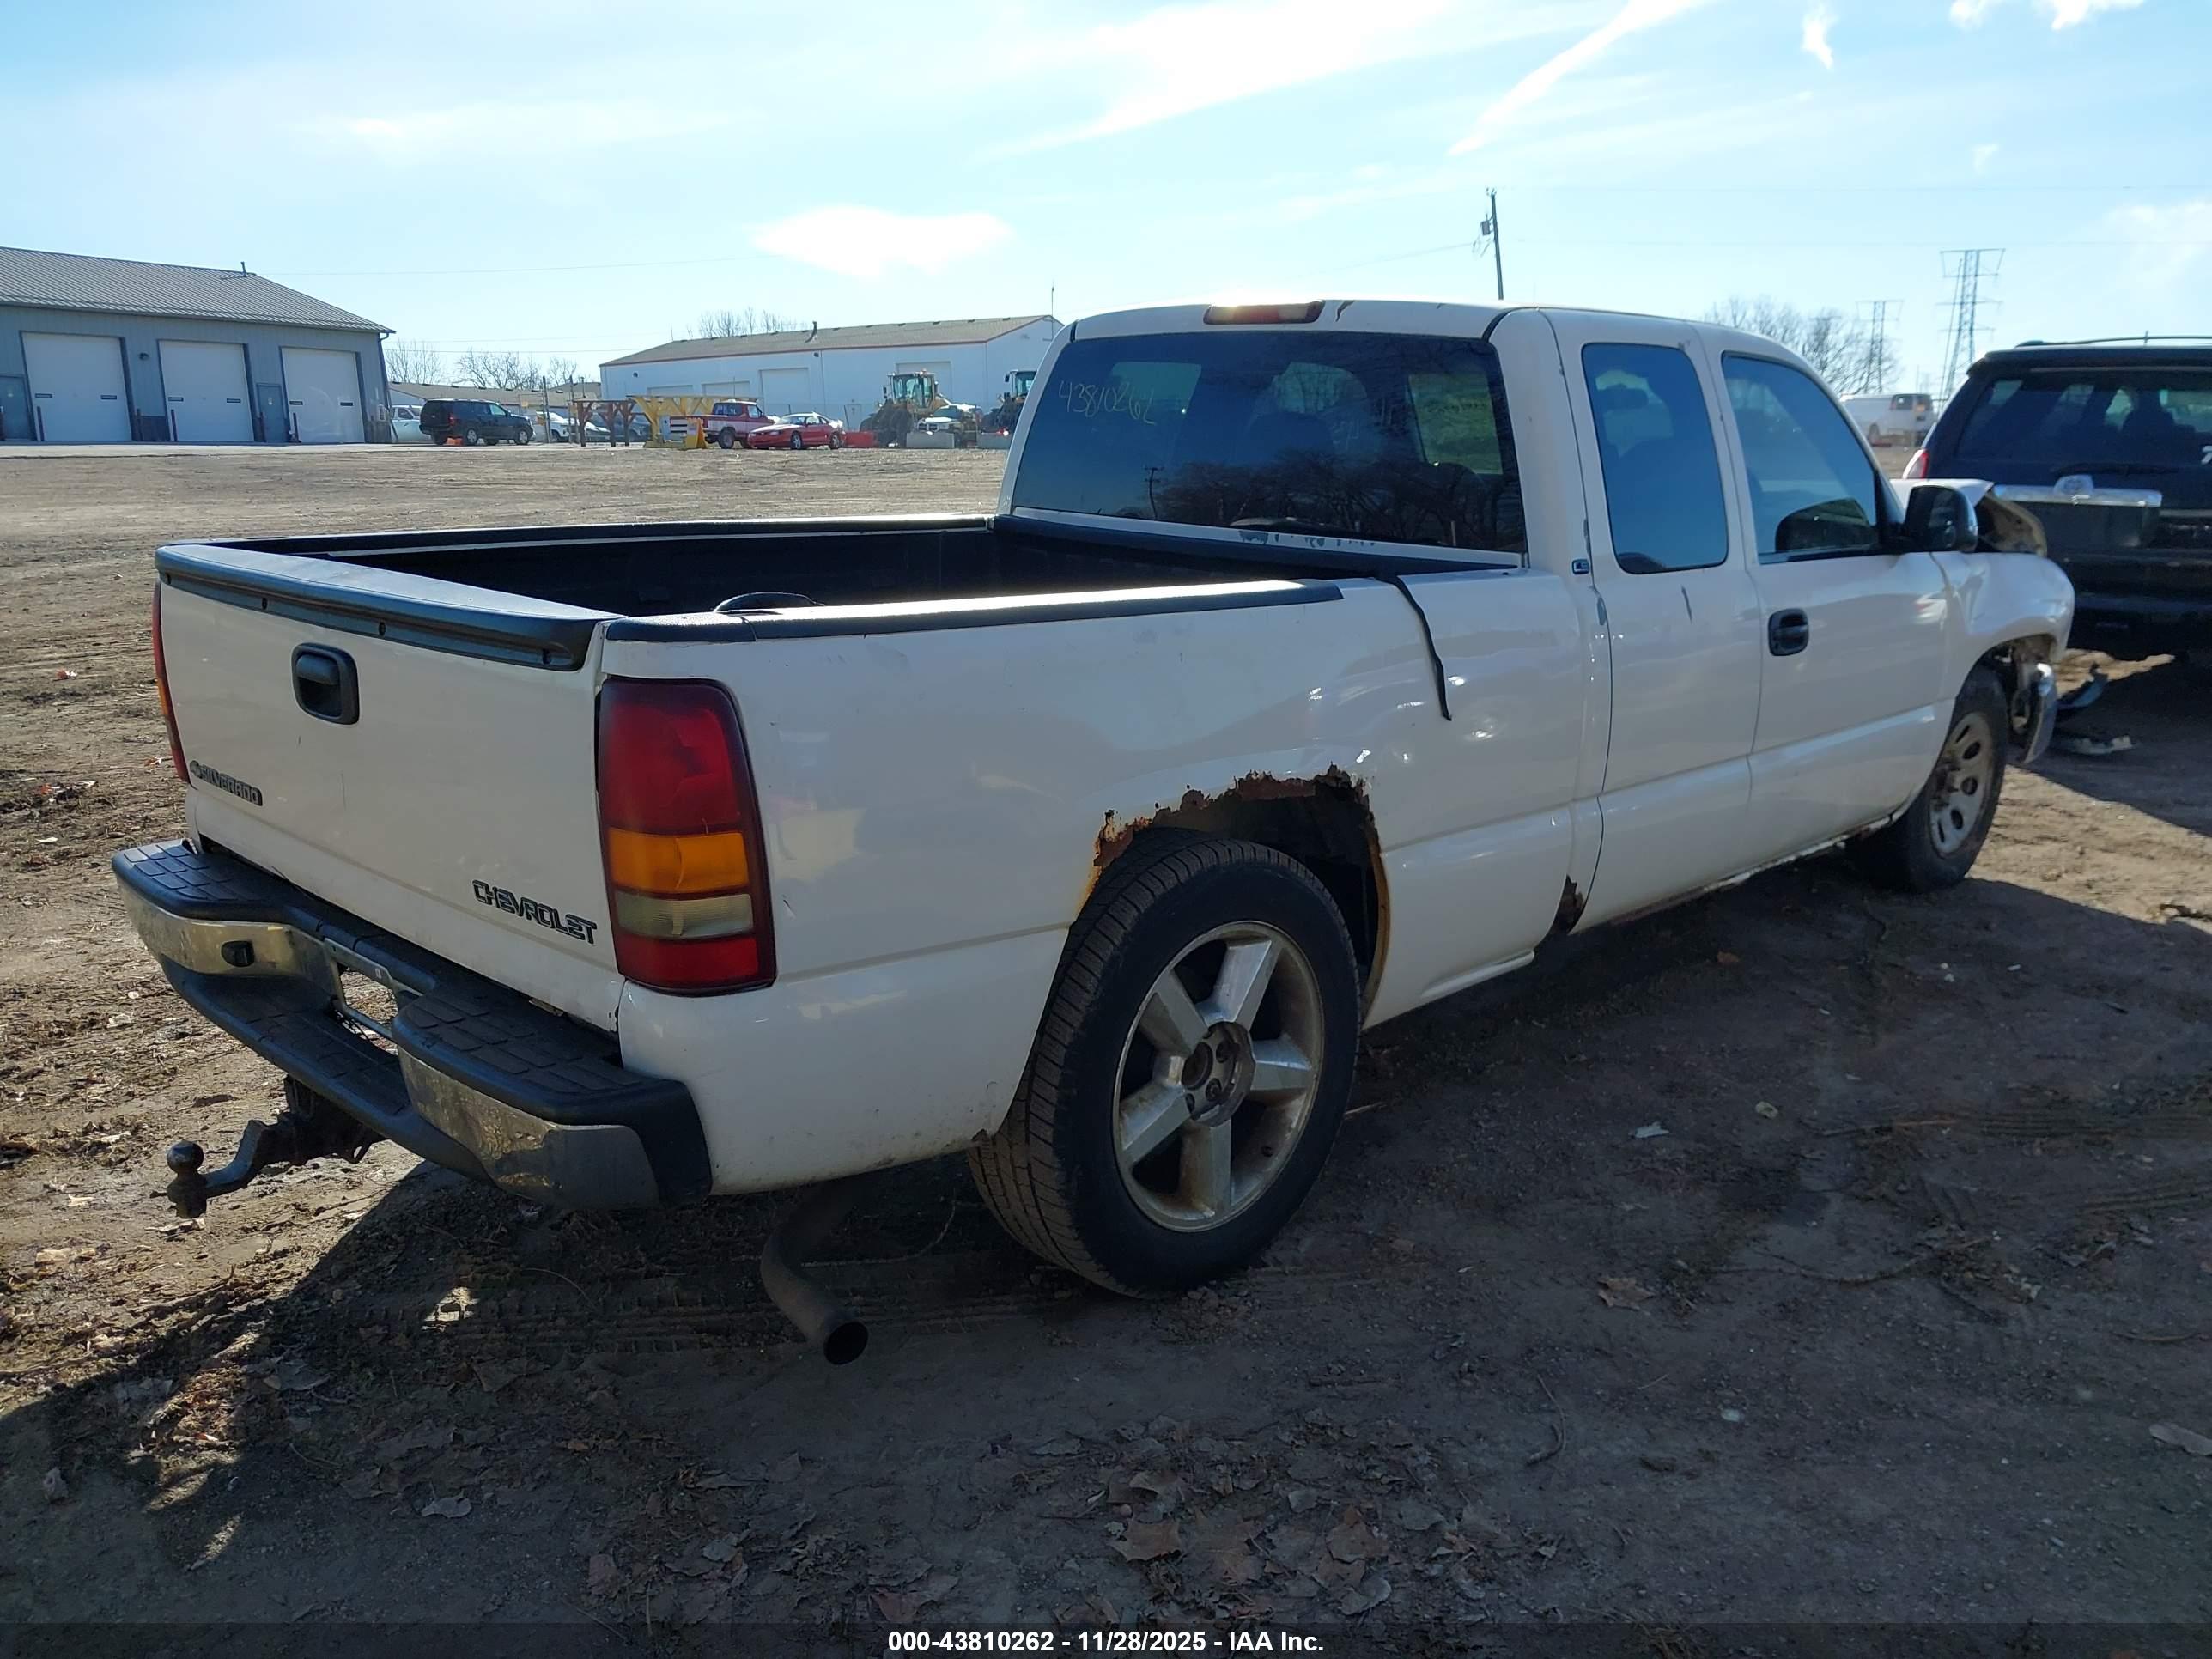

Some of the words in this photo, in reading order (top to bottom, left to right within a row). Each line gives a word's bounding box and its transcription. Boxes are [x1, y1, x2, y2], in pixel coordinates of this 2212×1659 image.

[1058, 380, 1158, 426] 43810262
[198, 763, 263, 806] SILVERADO
[471, 879, 598, 945] CHEVROLET
